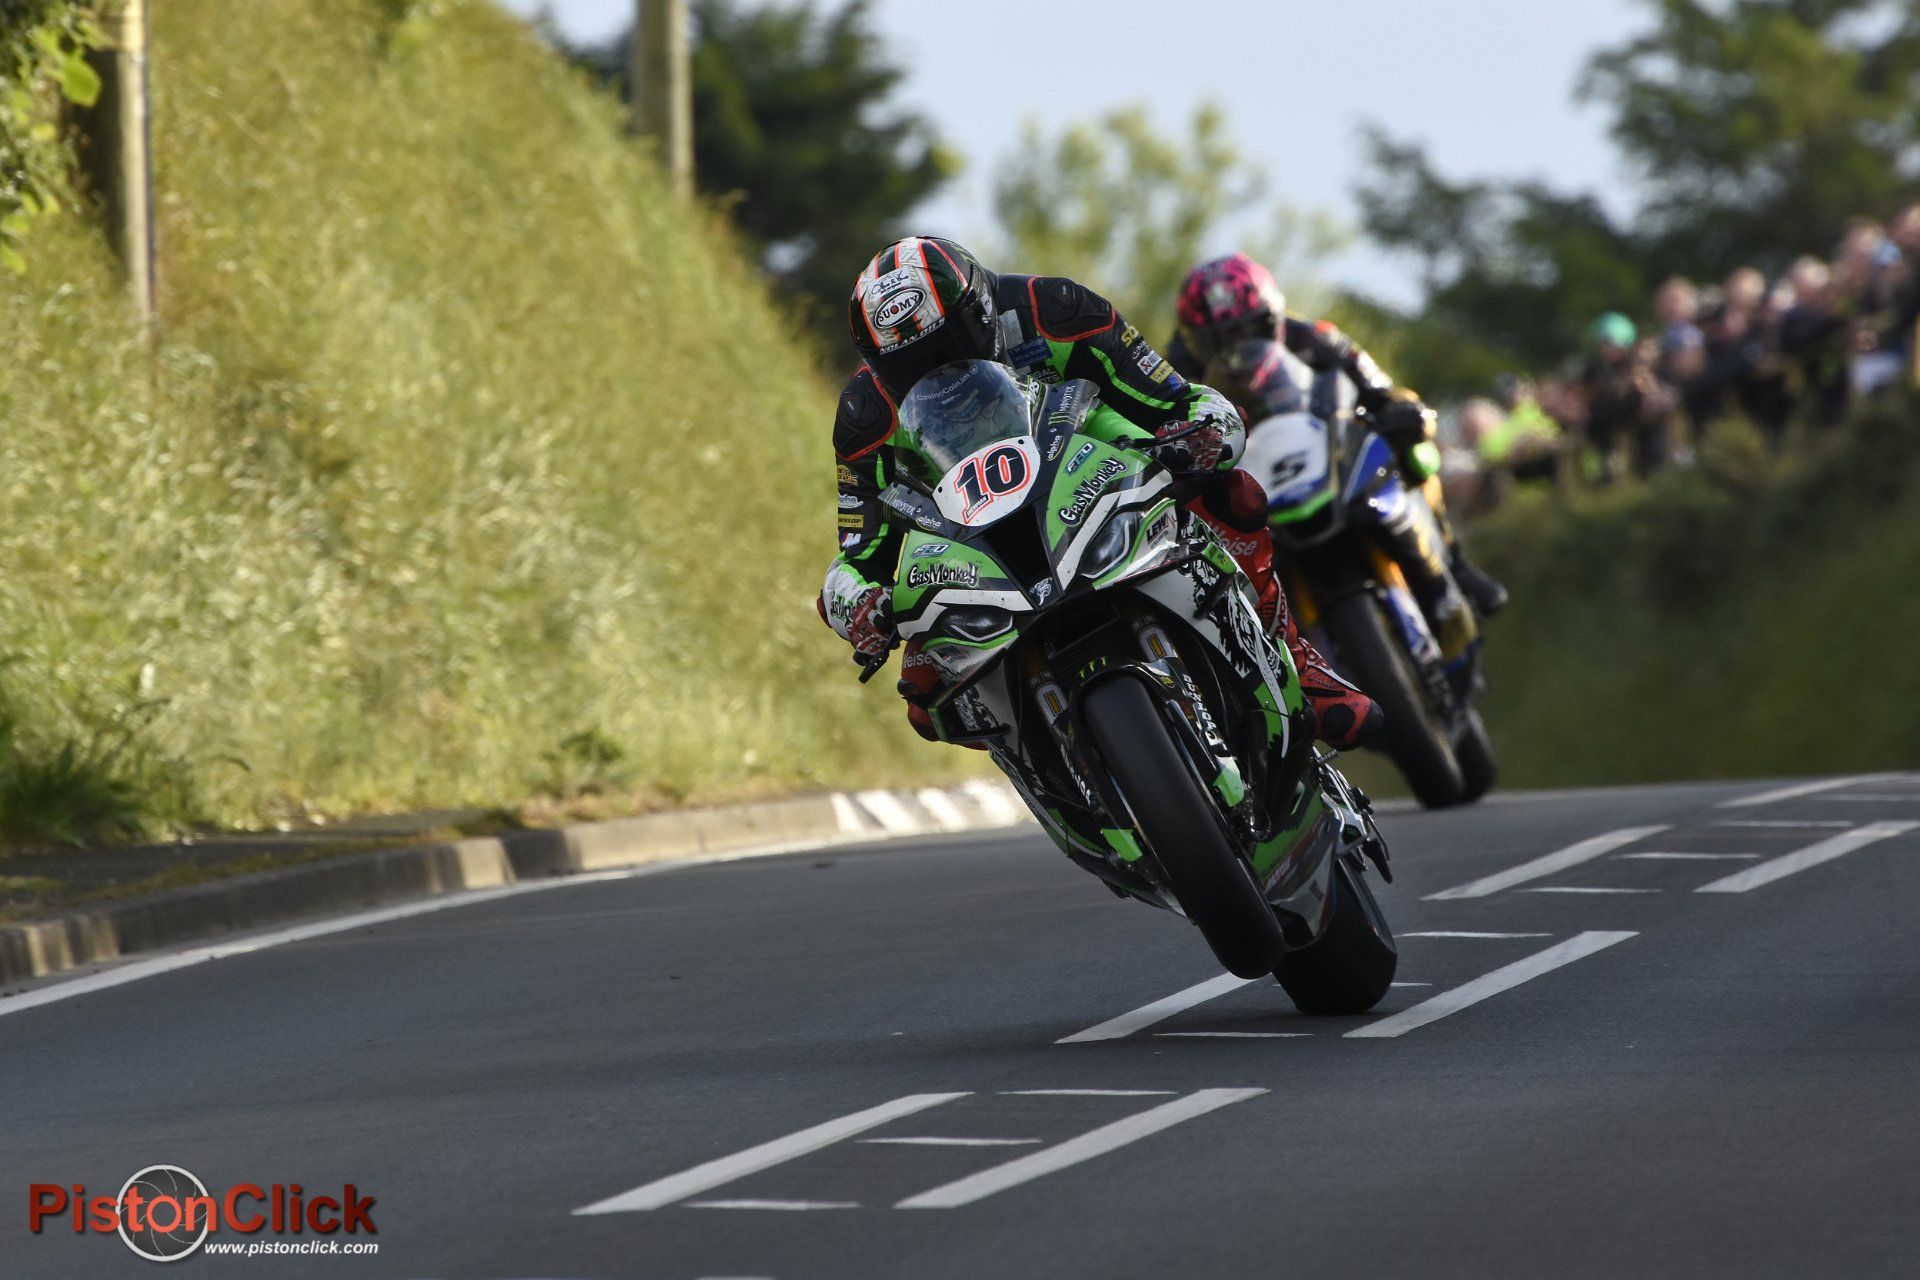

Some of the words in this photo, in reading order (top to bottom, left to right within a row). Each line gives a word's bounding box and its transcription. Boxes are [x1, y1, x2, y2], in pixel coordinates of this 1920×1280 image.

[879, 295, 919, 322] SUOMY
[880, 334, 919, 354] NOLAN
[917, 373, 971, 401] CasinoCoin.im
[954, 445, 1031, 525] 10
